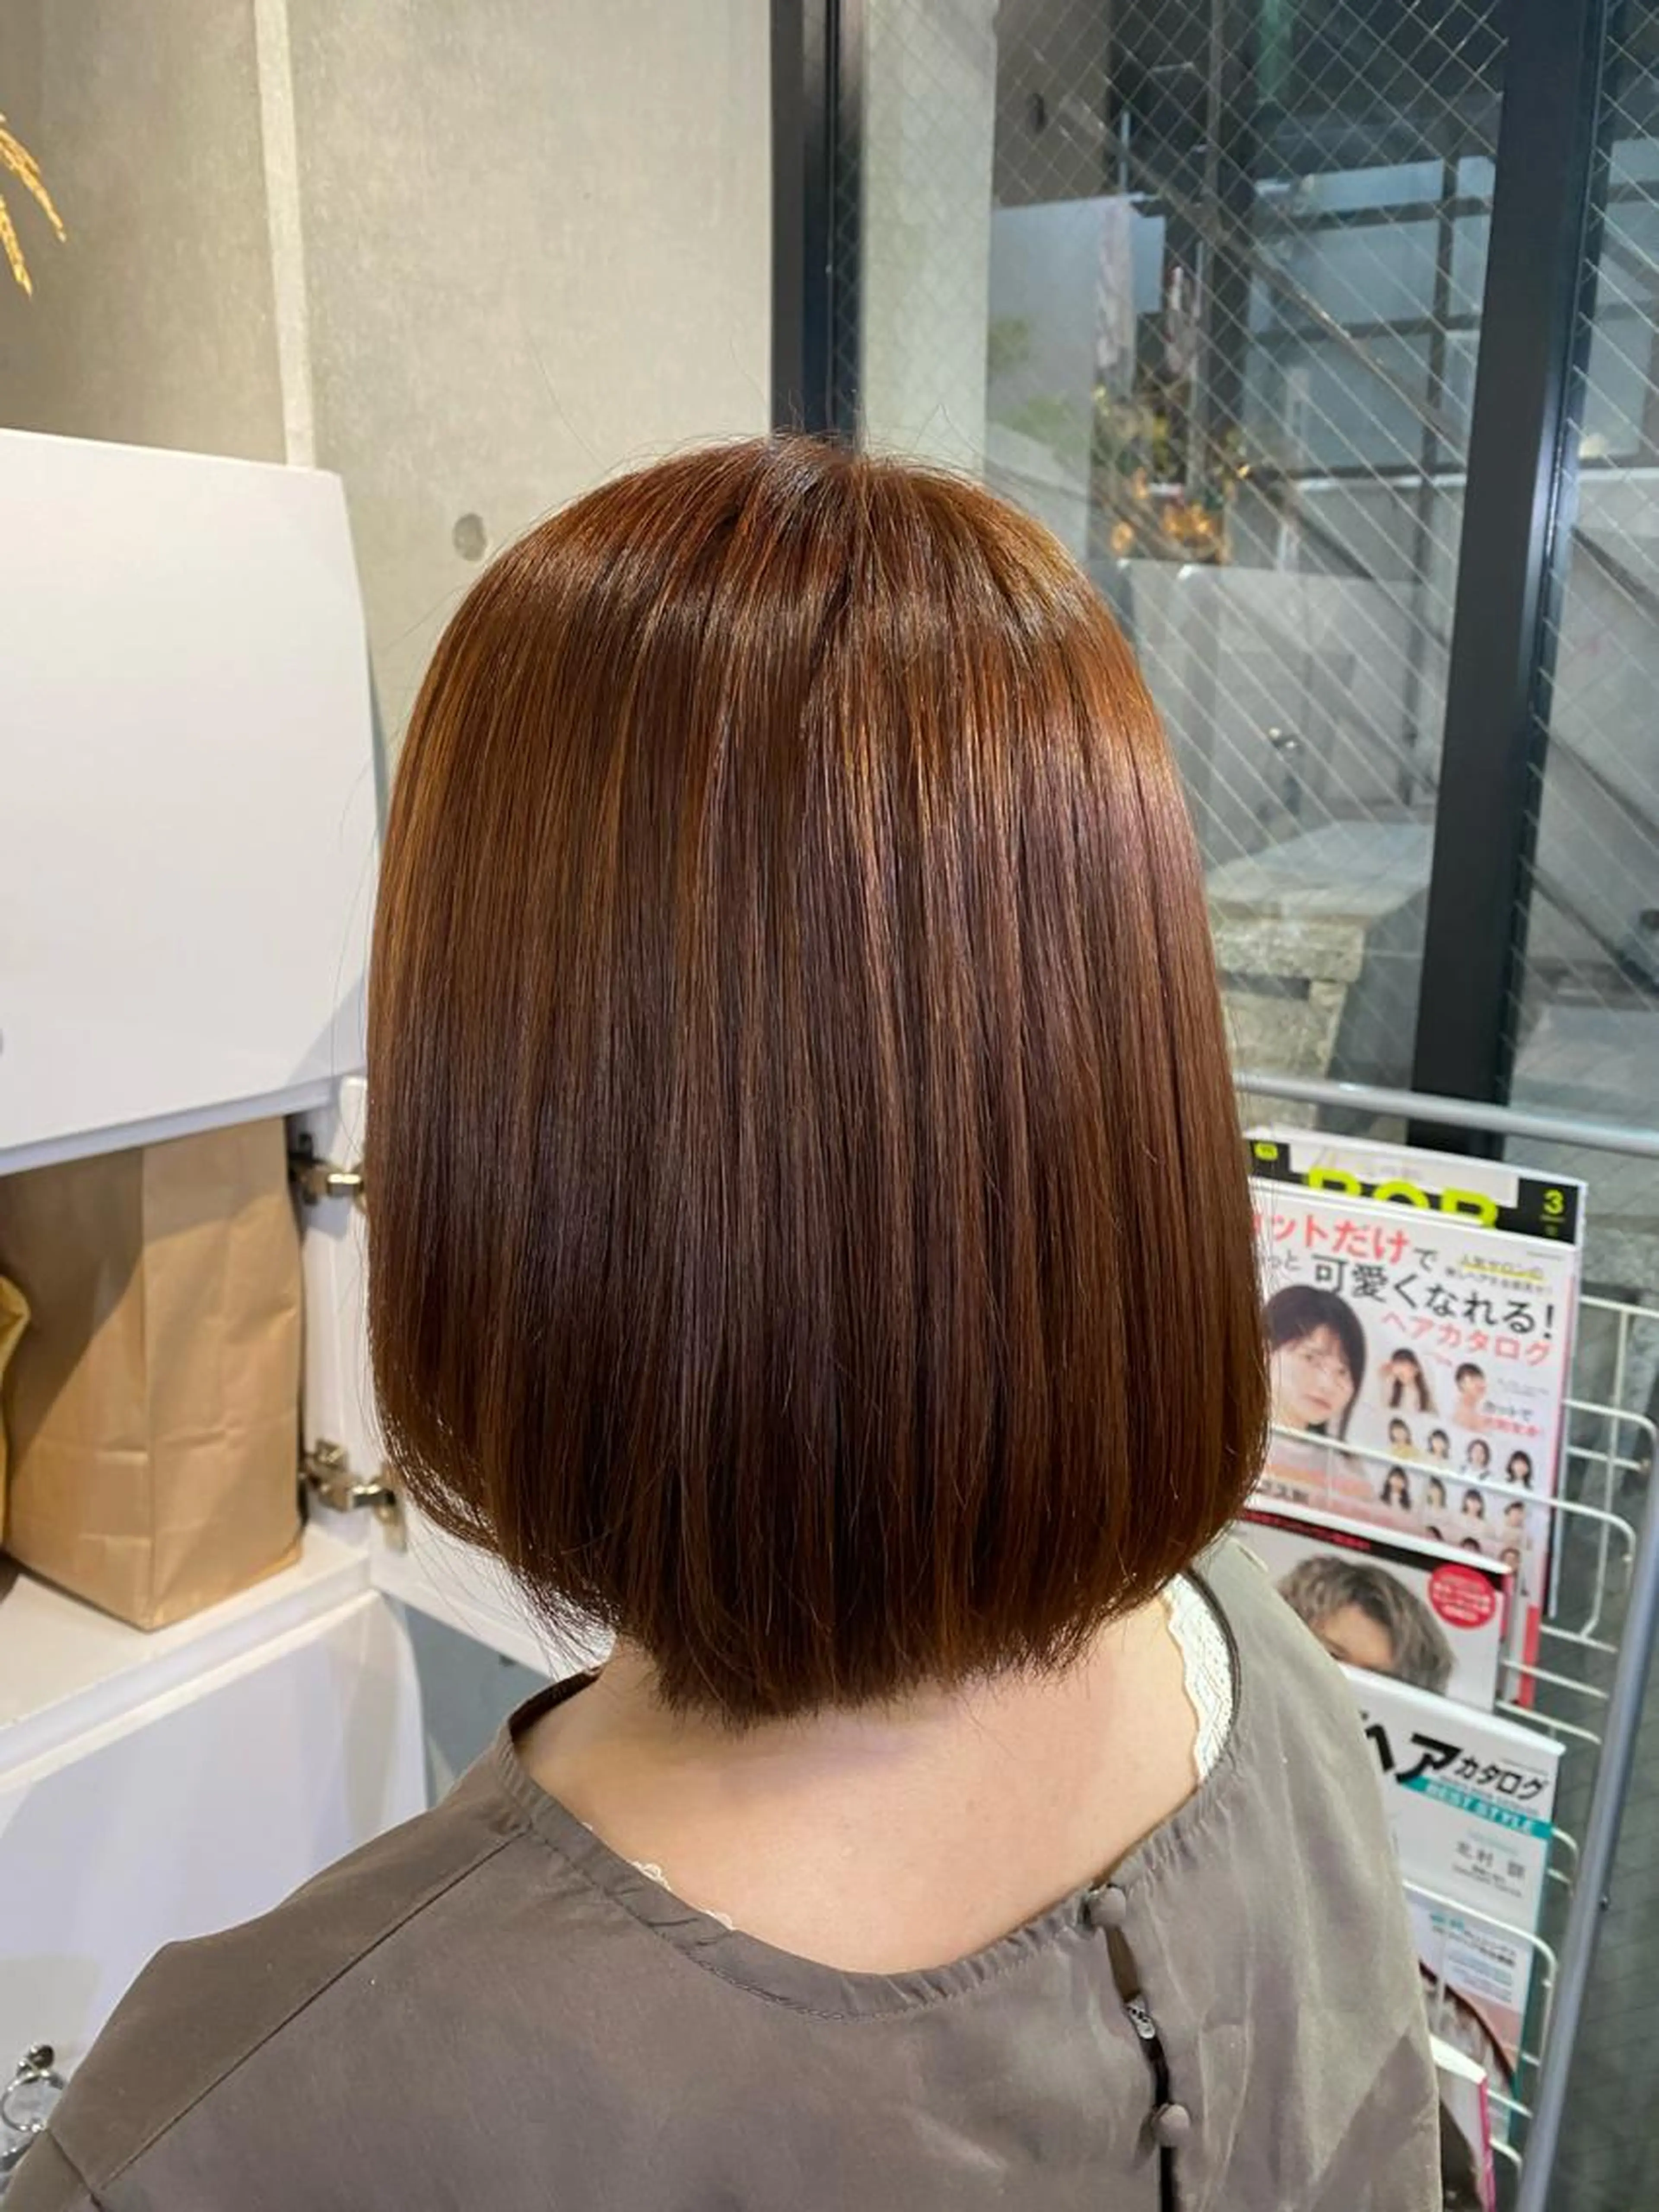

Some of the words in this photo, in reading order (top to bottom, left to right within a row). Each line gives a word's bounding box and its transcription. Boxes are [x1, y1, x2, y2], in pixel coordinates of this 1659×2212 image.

[1544, 1189, 1564, 1215] 3
[1382, 1311, 1552, 1367] ヘアカタログ
